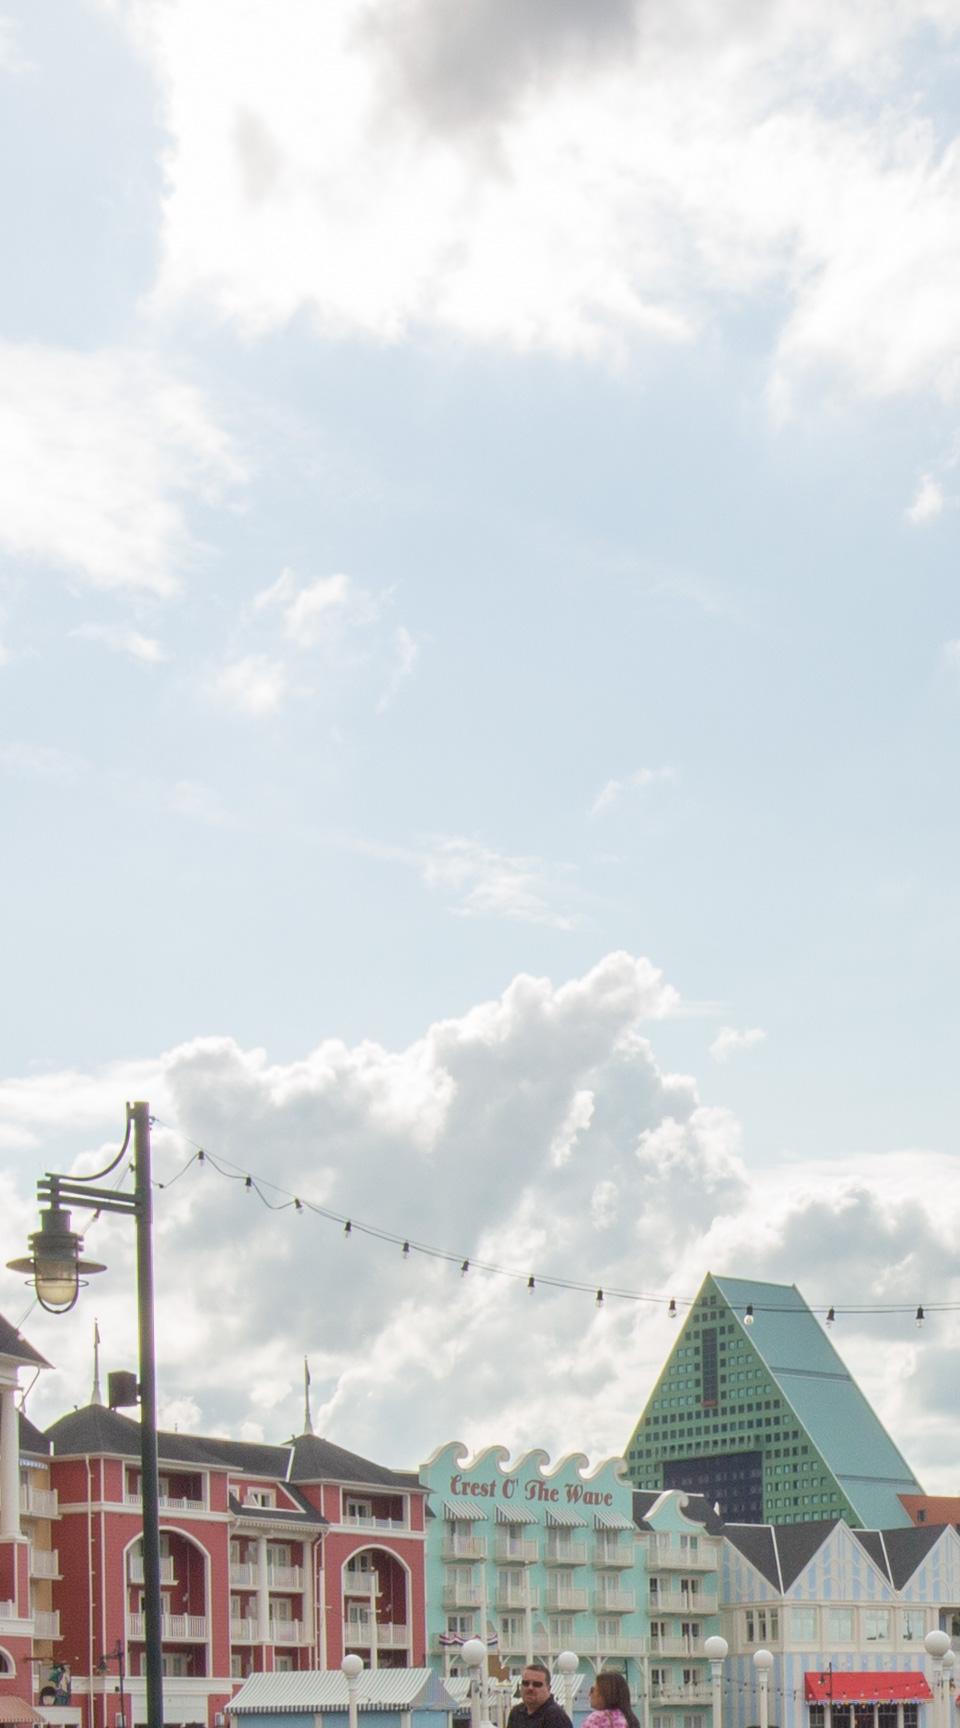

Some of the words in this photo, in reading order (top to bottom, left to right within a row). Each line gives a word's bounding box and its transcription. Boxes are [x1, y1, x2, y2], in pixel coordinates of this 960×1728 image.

[450, 1474, 497, 1498] Crest
[525, 1479, 560, 1503] The
[564, 1483, 613, 1507] Wave
